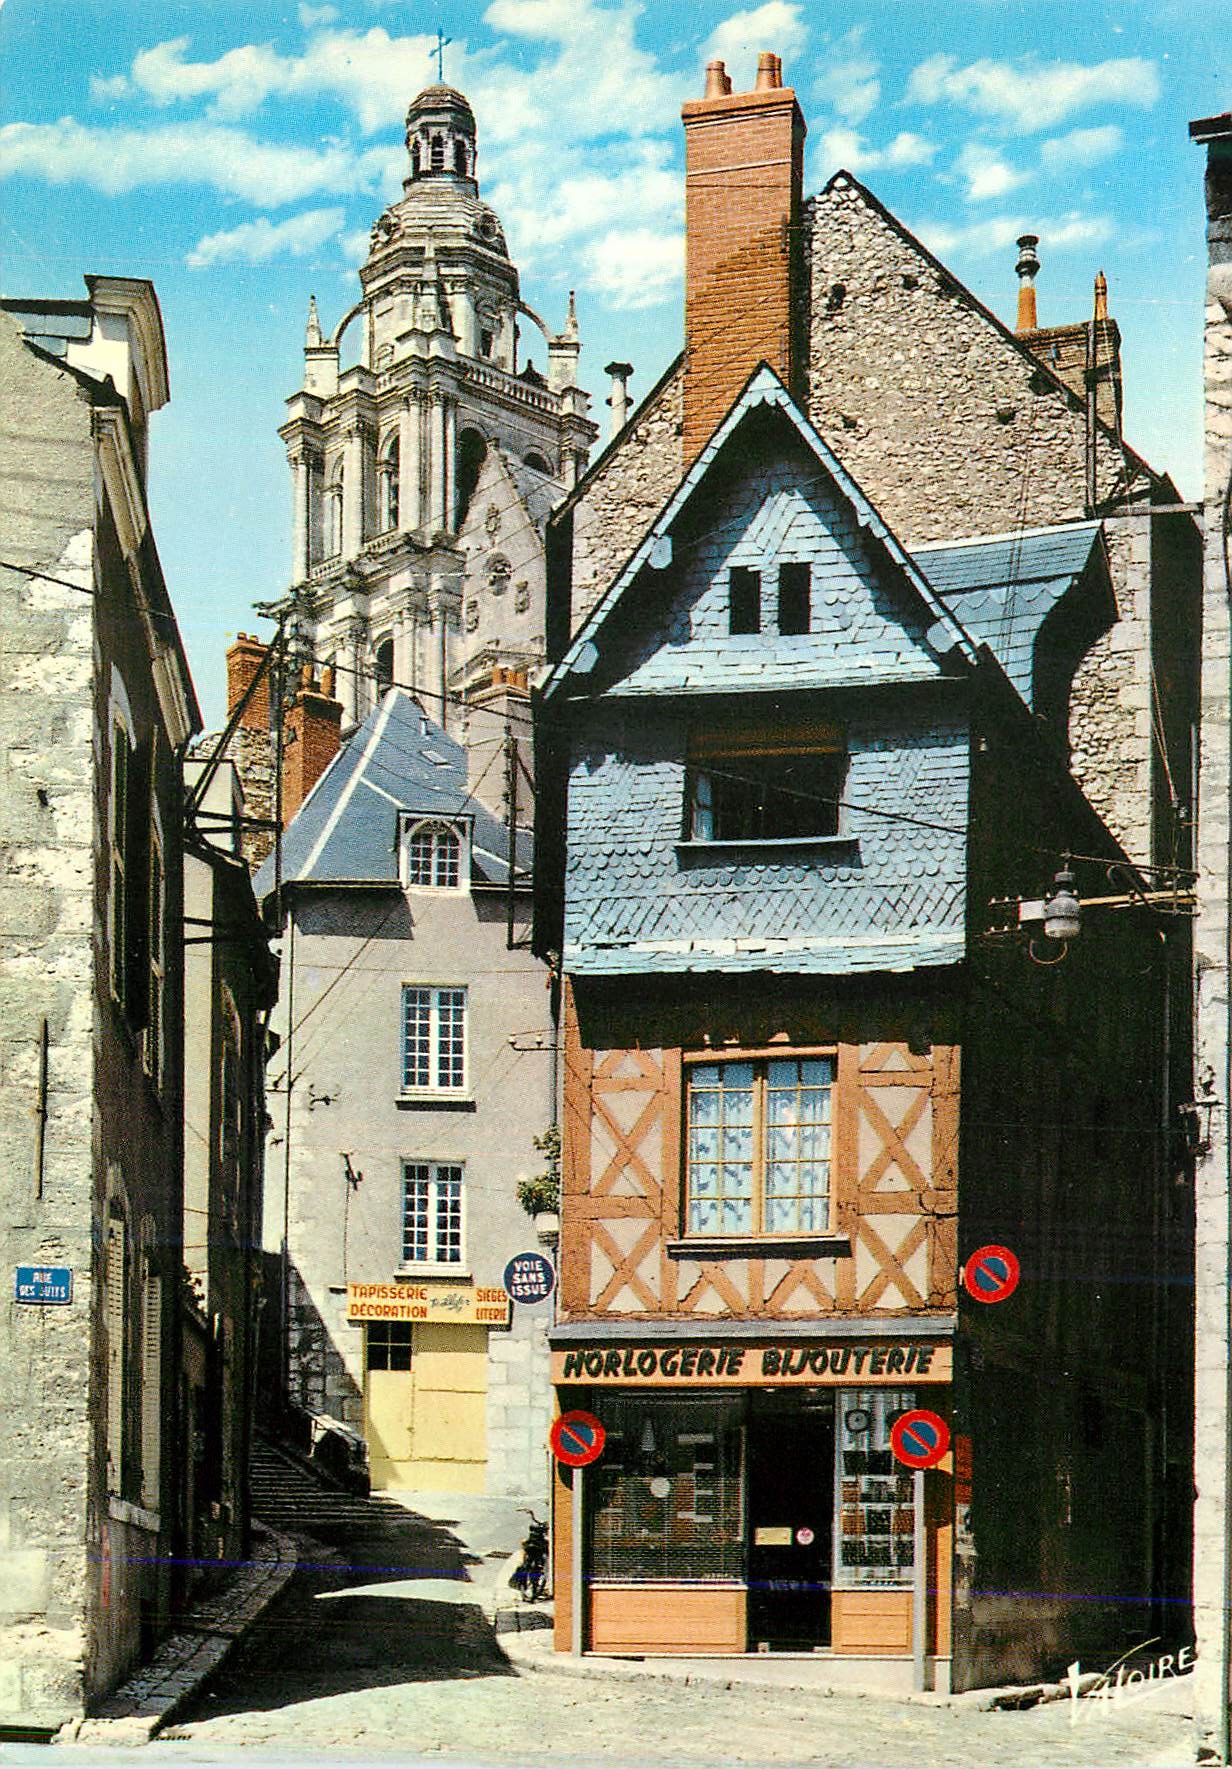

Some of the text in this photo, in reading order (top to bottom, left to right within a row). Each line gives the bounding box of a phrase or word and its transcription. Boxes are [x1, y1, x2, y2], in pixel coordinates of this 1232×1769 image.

[514, 1260, 543, 1271] VOIE
[512, 1272, 545, 1283] SANS
[352, 1285, 428, 1300] TAPISSERIE
[511, 1284, 548, 1296] ISSUE
[476, 1307, 506, 1320] LITERIE
[563, 1345, 936, 1378] HORLOGERIE BIJOUTERIE
